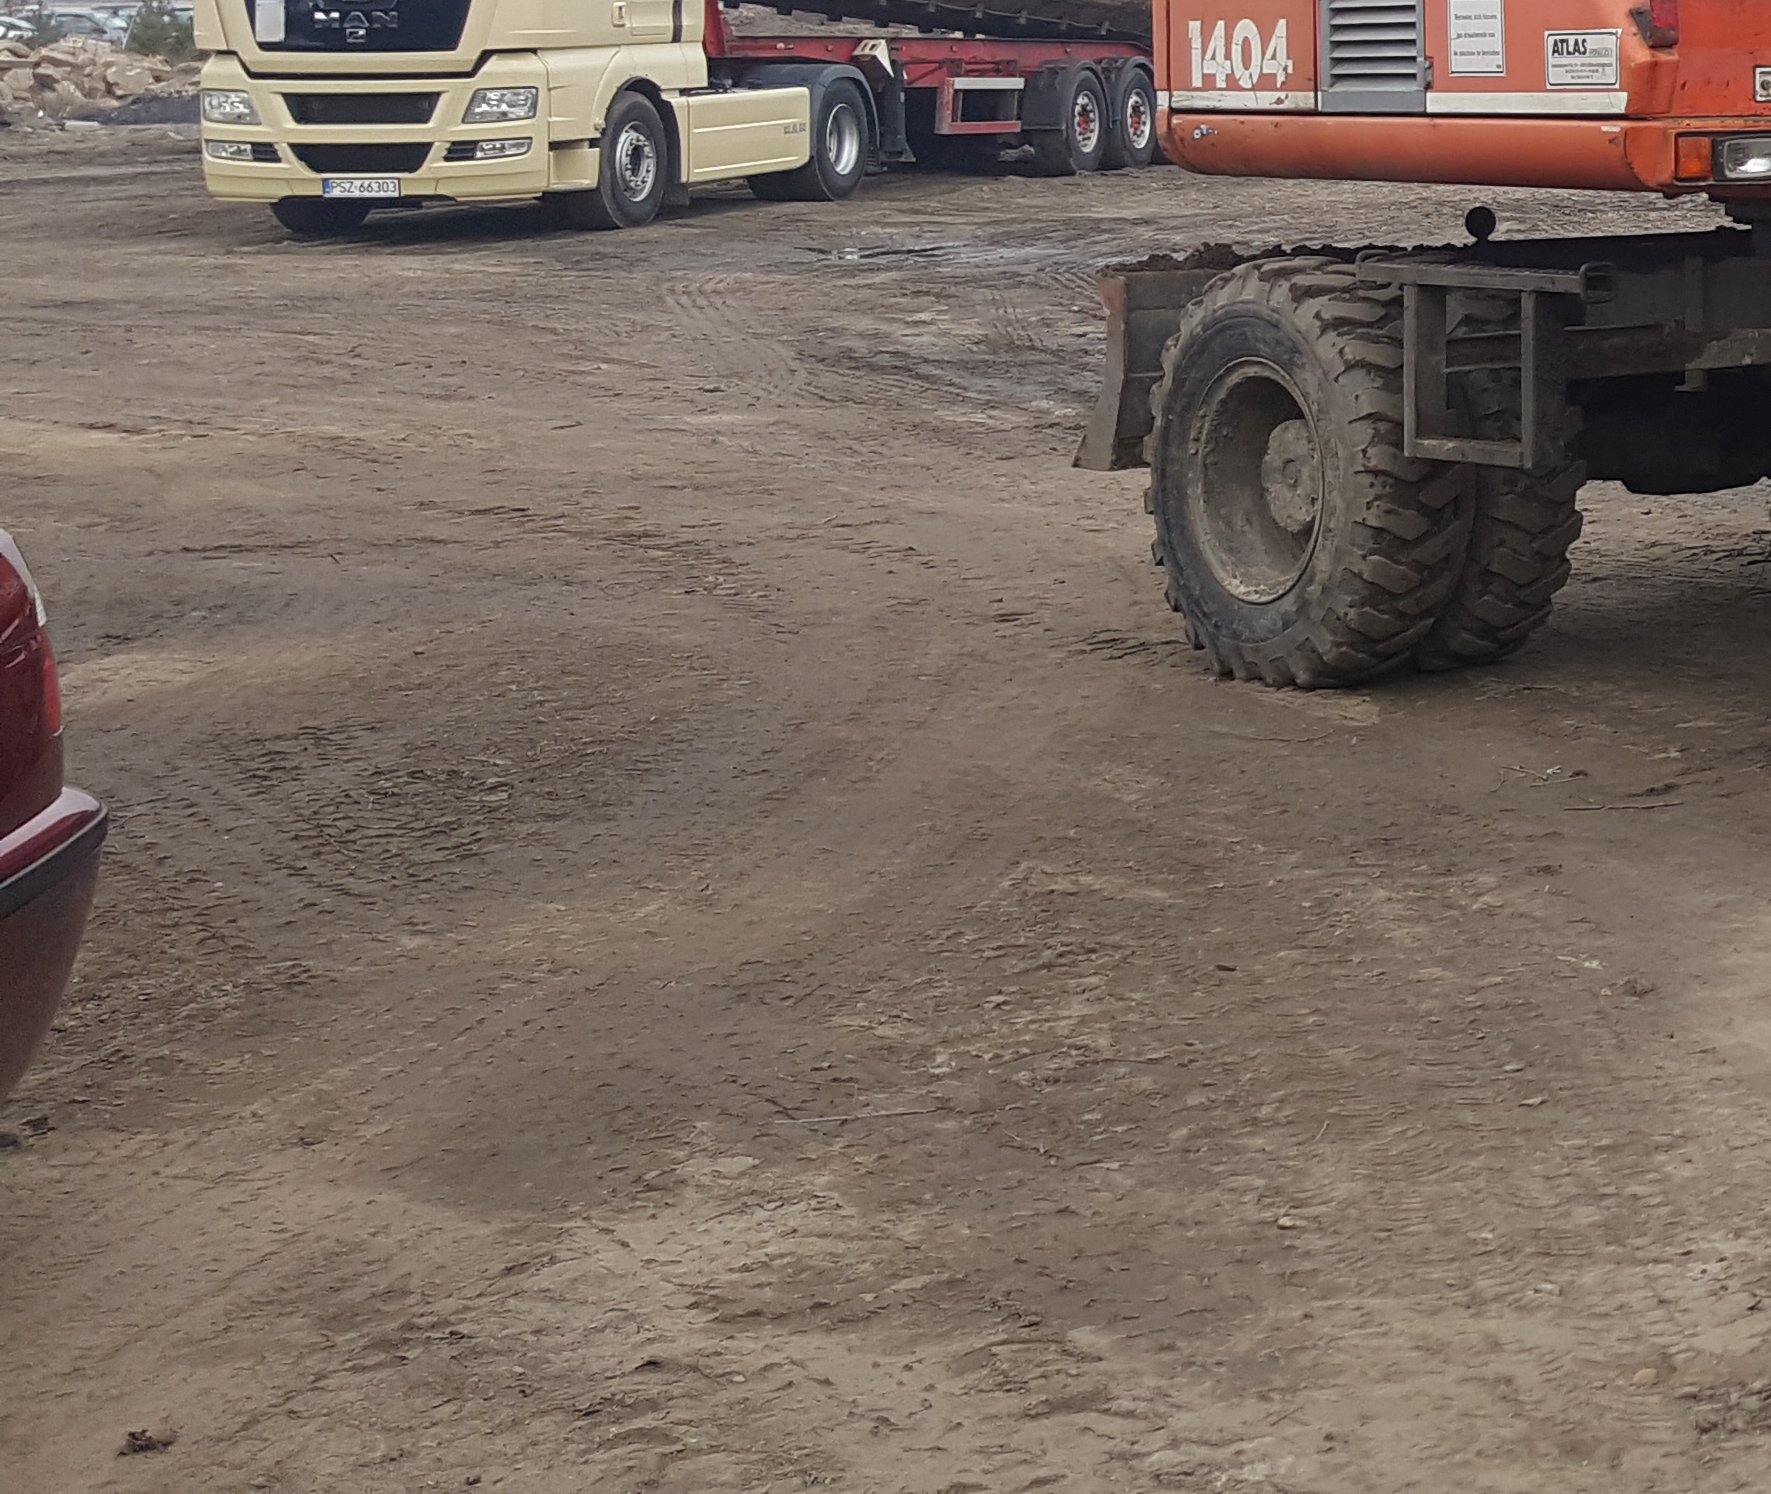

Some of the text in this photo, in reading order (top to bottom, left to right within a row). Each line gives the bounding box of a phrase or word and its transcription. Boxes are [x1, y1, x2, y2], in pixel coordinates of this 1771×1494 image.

[313, 10, 399, 28] MAN
[1188, 18, 1294, 88] 1404
[1551, 38, 1588, 56] ATLAS
[331, 181, 397, 194] PSZ 66303
